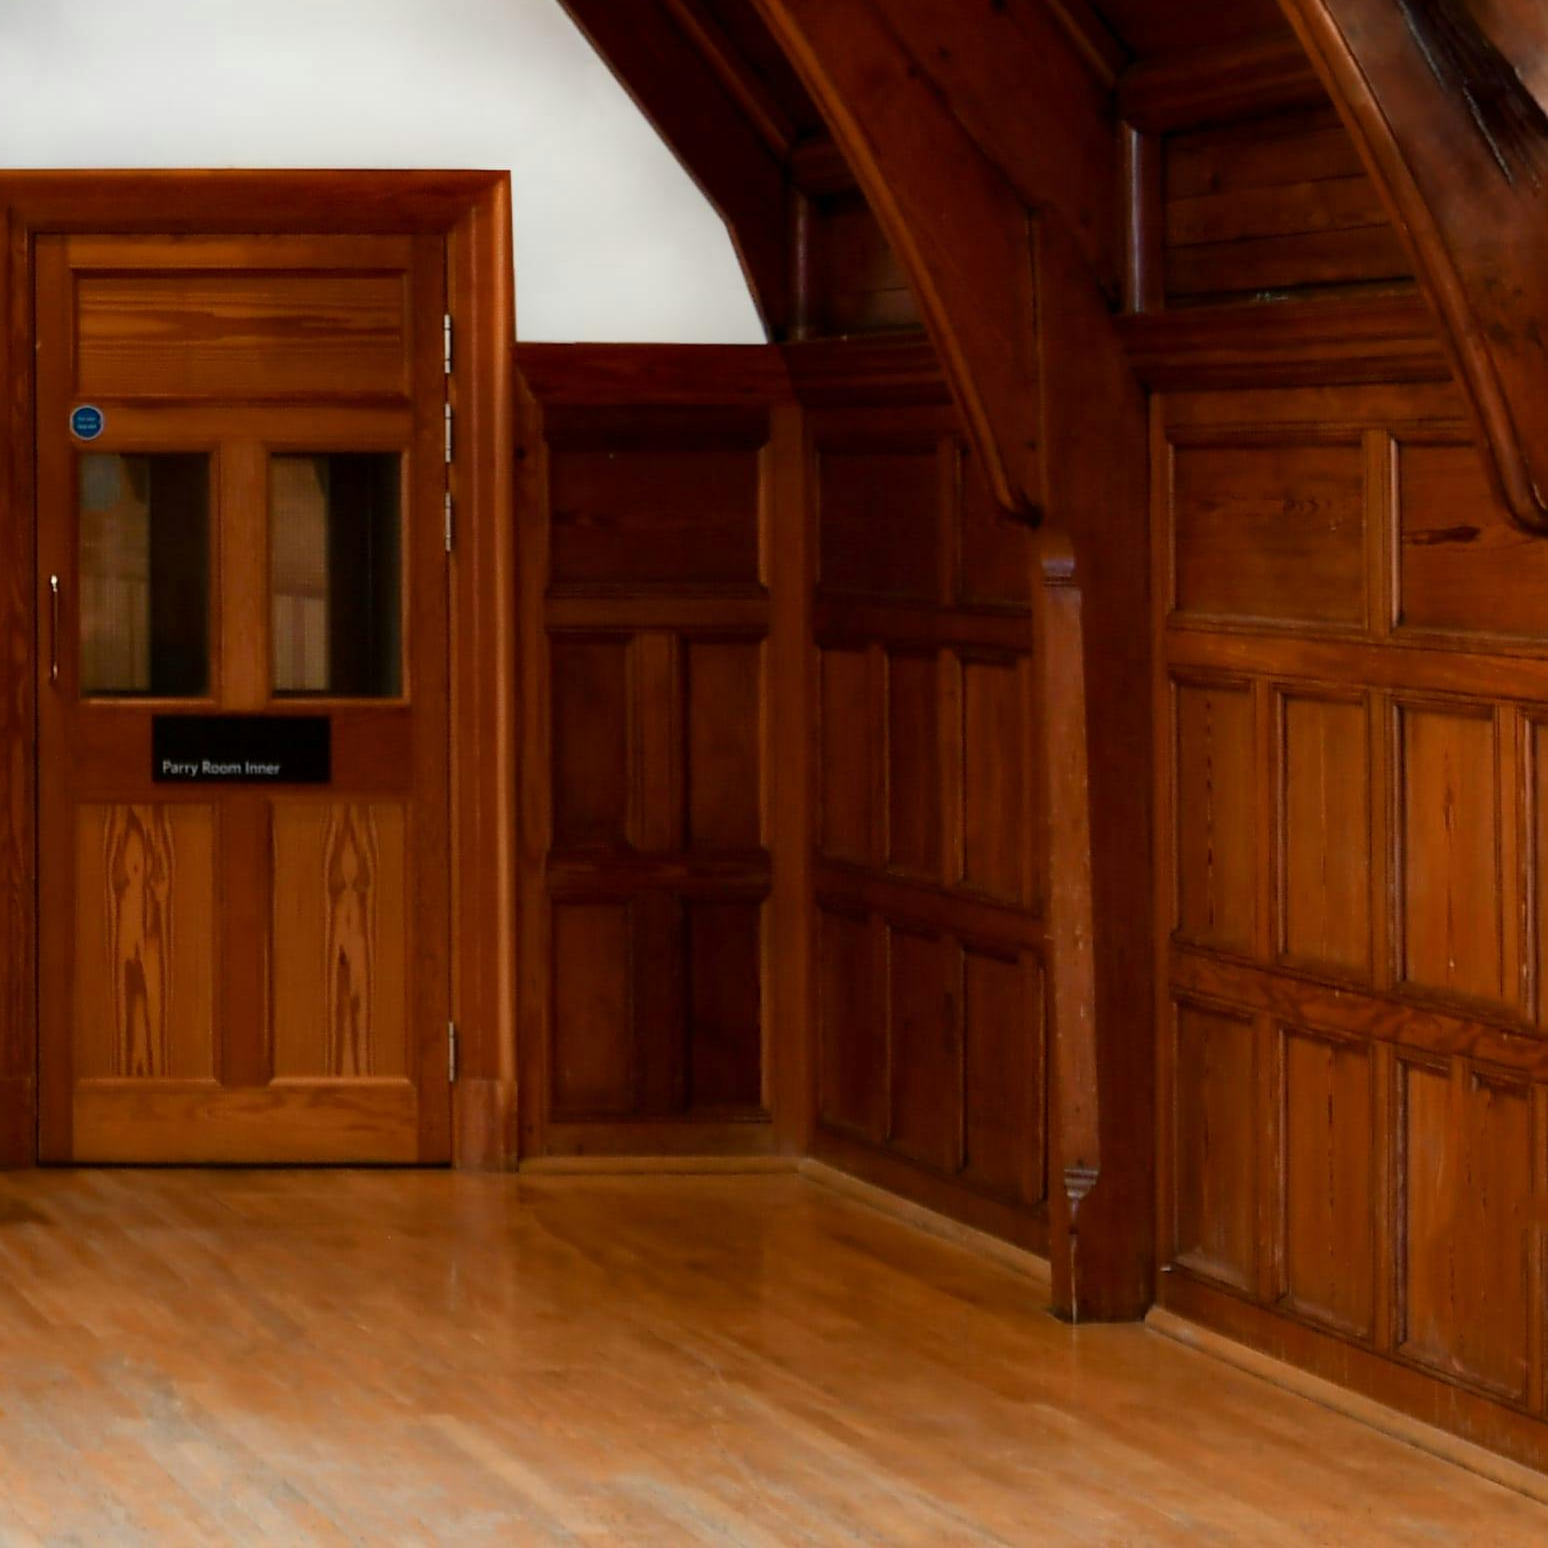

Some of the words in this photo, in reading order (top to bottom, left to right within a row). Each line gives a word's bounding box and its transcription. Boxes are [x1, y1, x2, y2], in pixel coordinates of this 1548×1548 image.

[162, 760, 199, 777] Parry
[202, 760, 242, 774] Room
[245, 760, 280, 774] Inner
